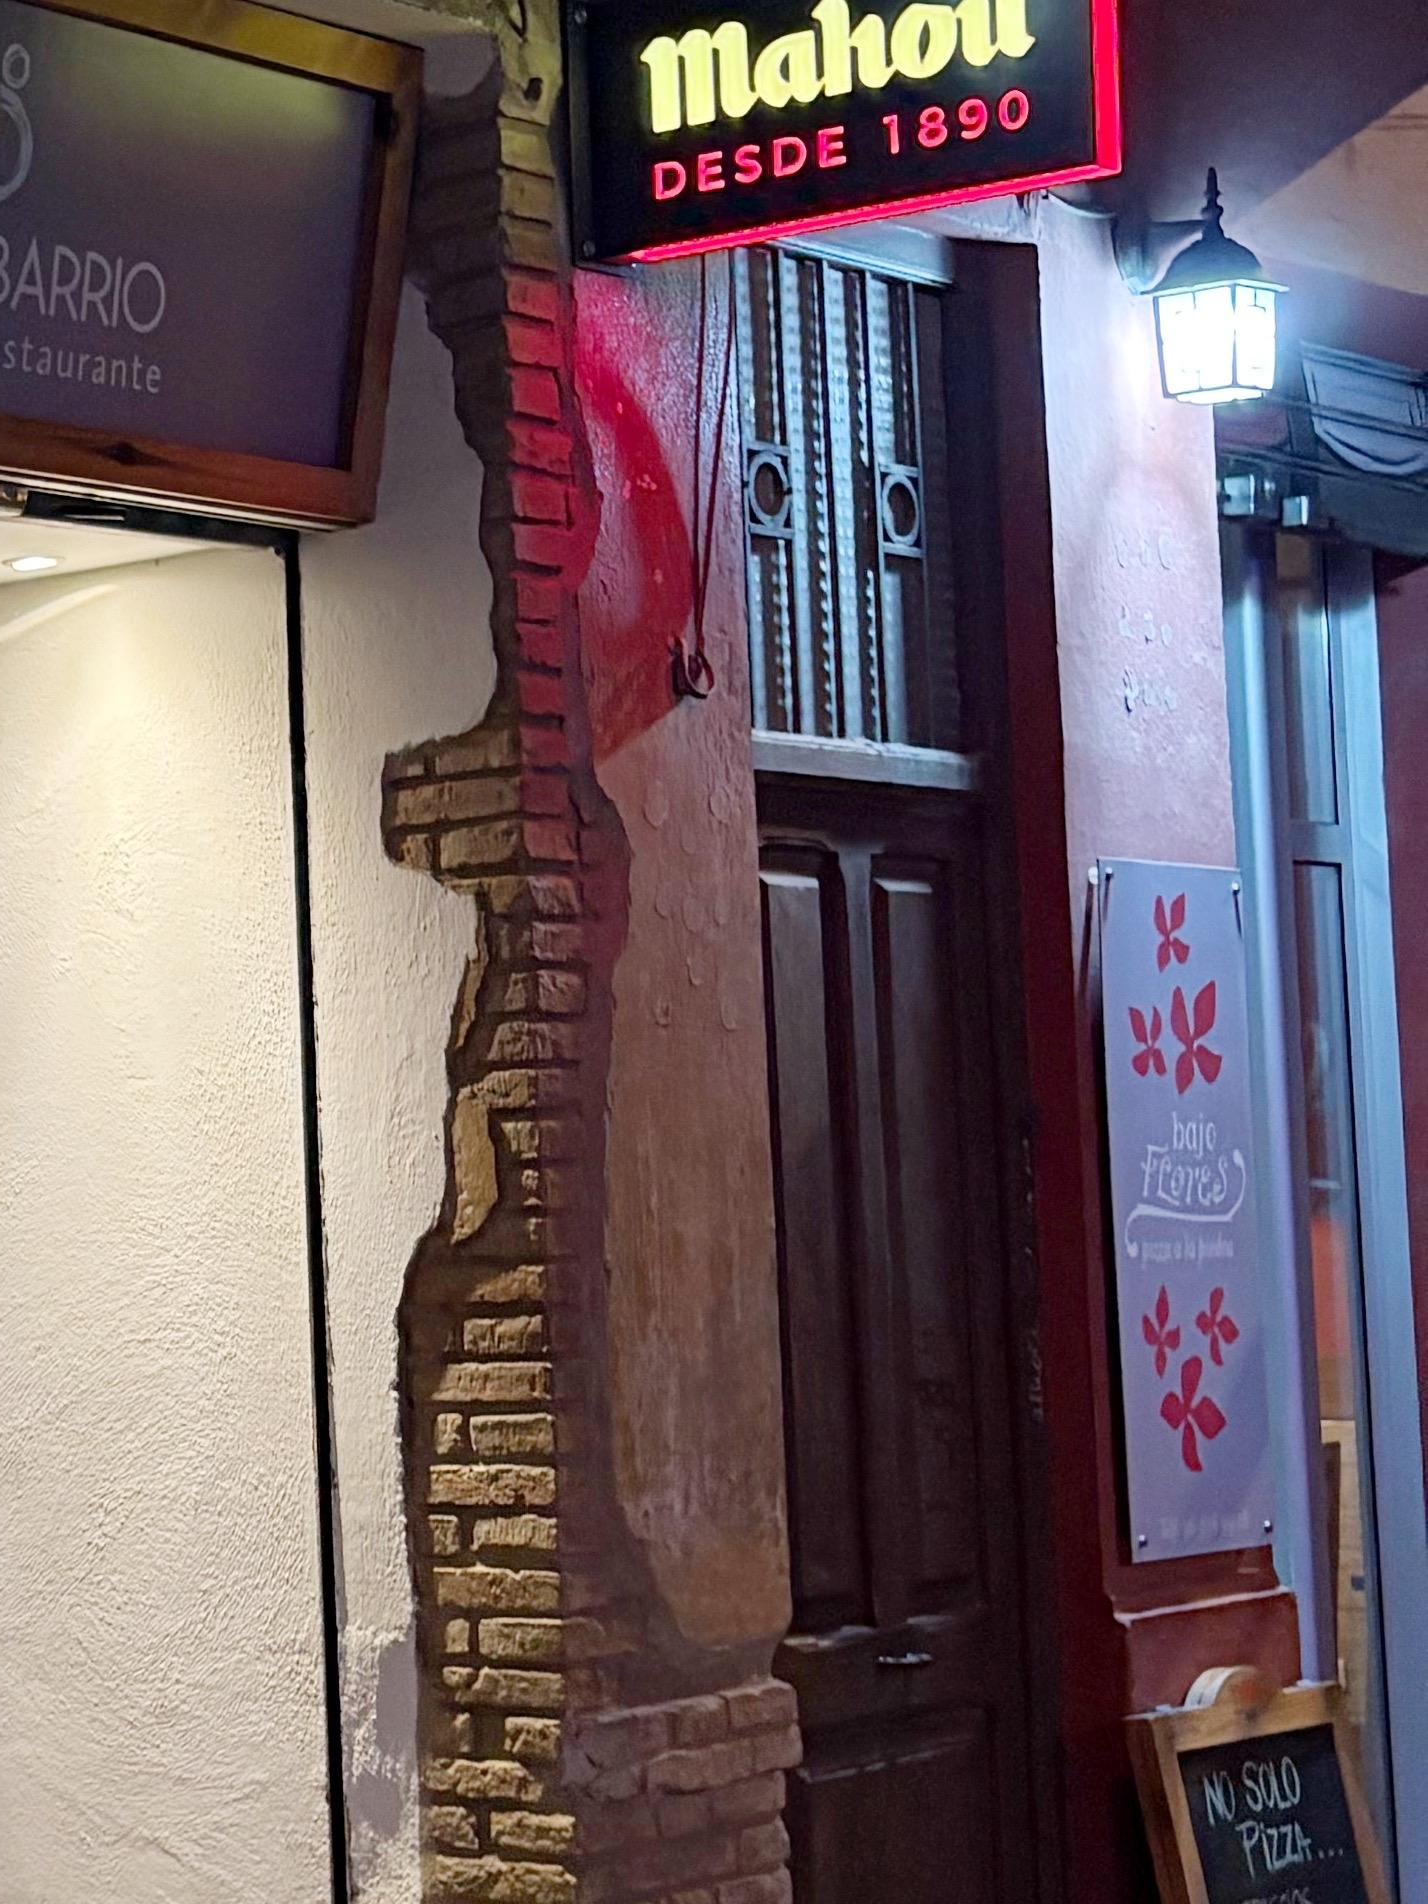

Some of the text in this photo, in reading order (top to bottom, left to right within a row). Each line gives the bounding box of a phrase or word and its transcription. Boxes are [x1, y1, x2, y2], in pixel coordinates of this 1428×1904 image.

[654, 89, 1030, 200] DESDE 1890
[1172, 1111, 1217, 1159] bajo
[1203, 1756, 1301, 1826] NO SOLO
